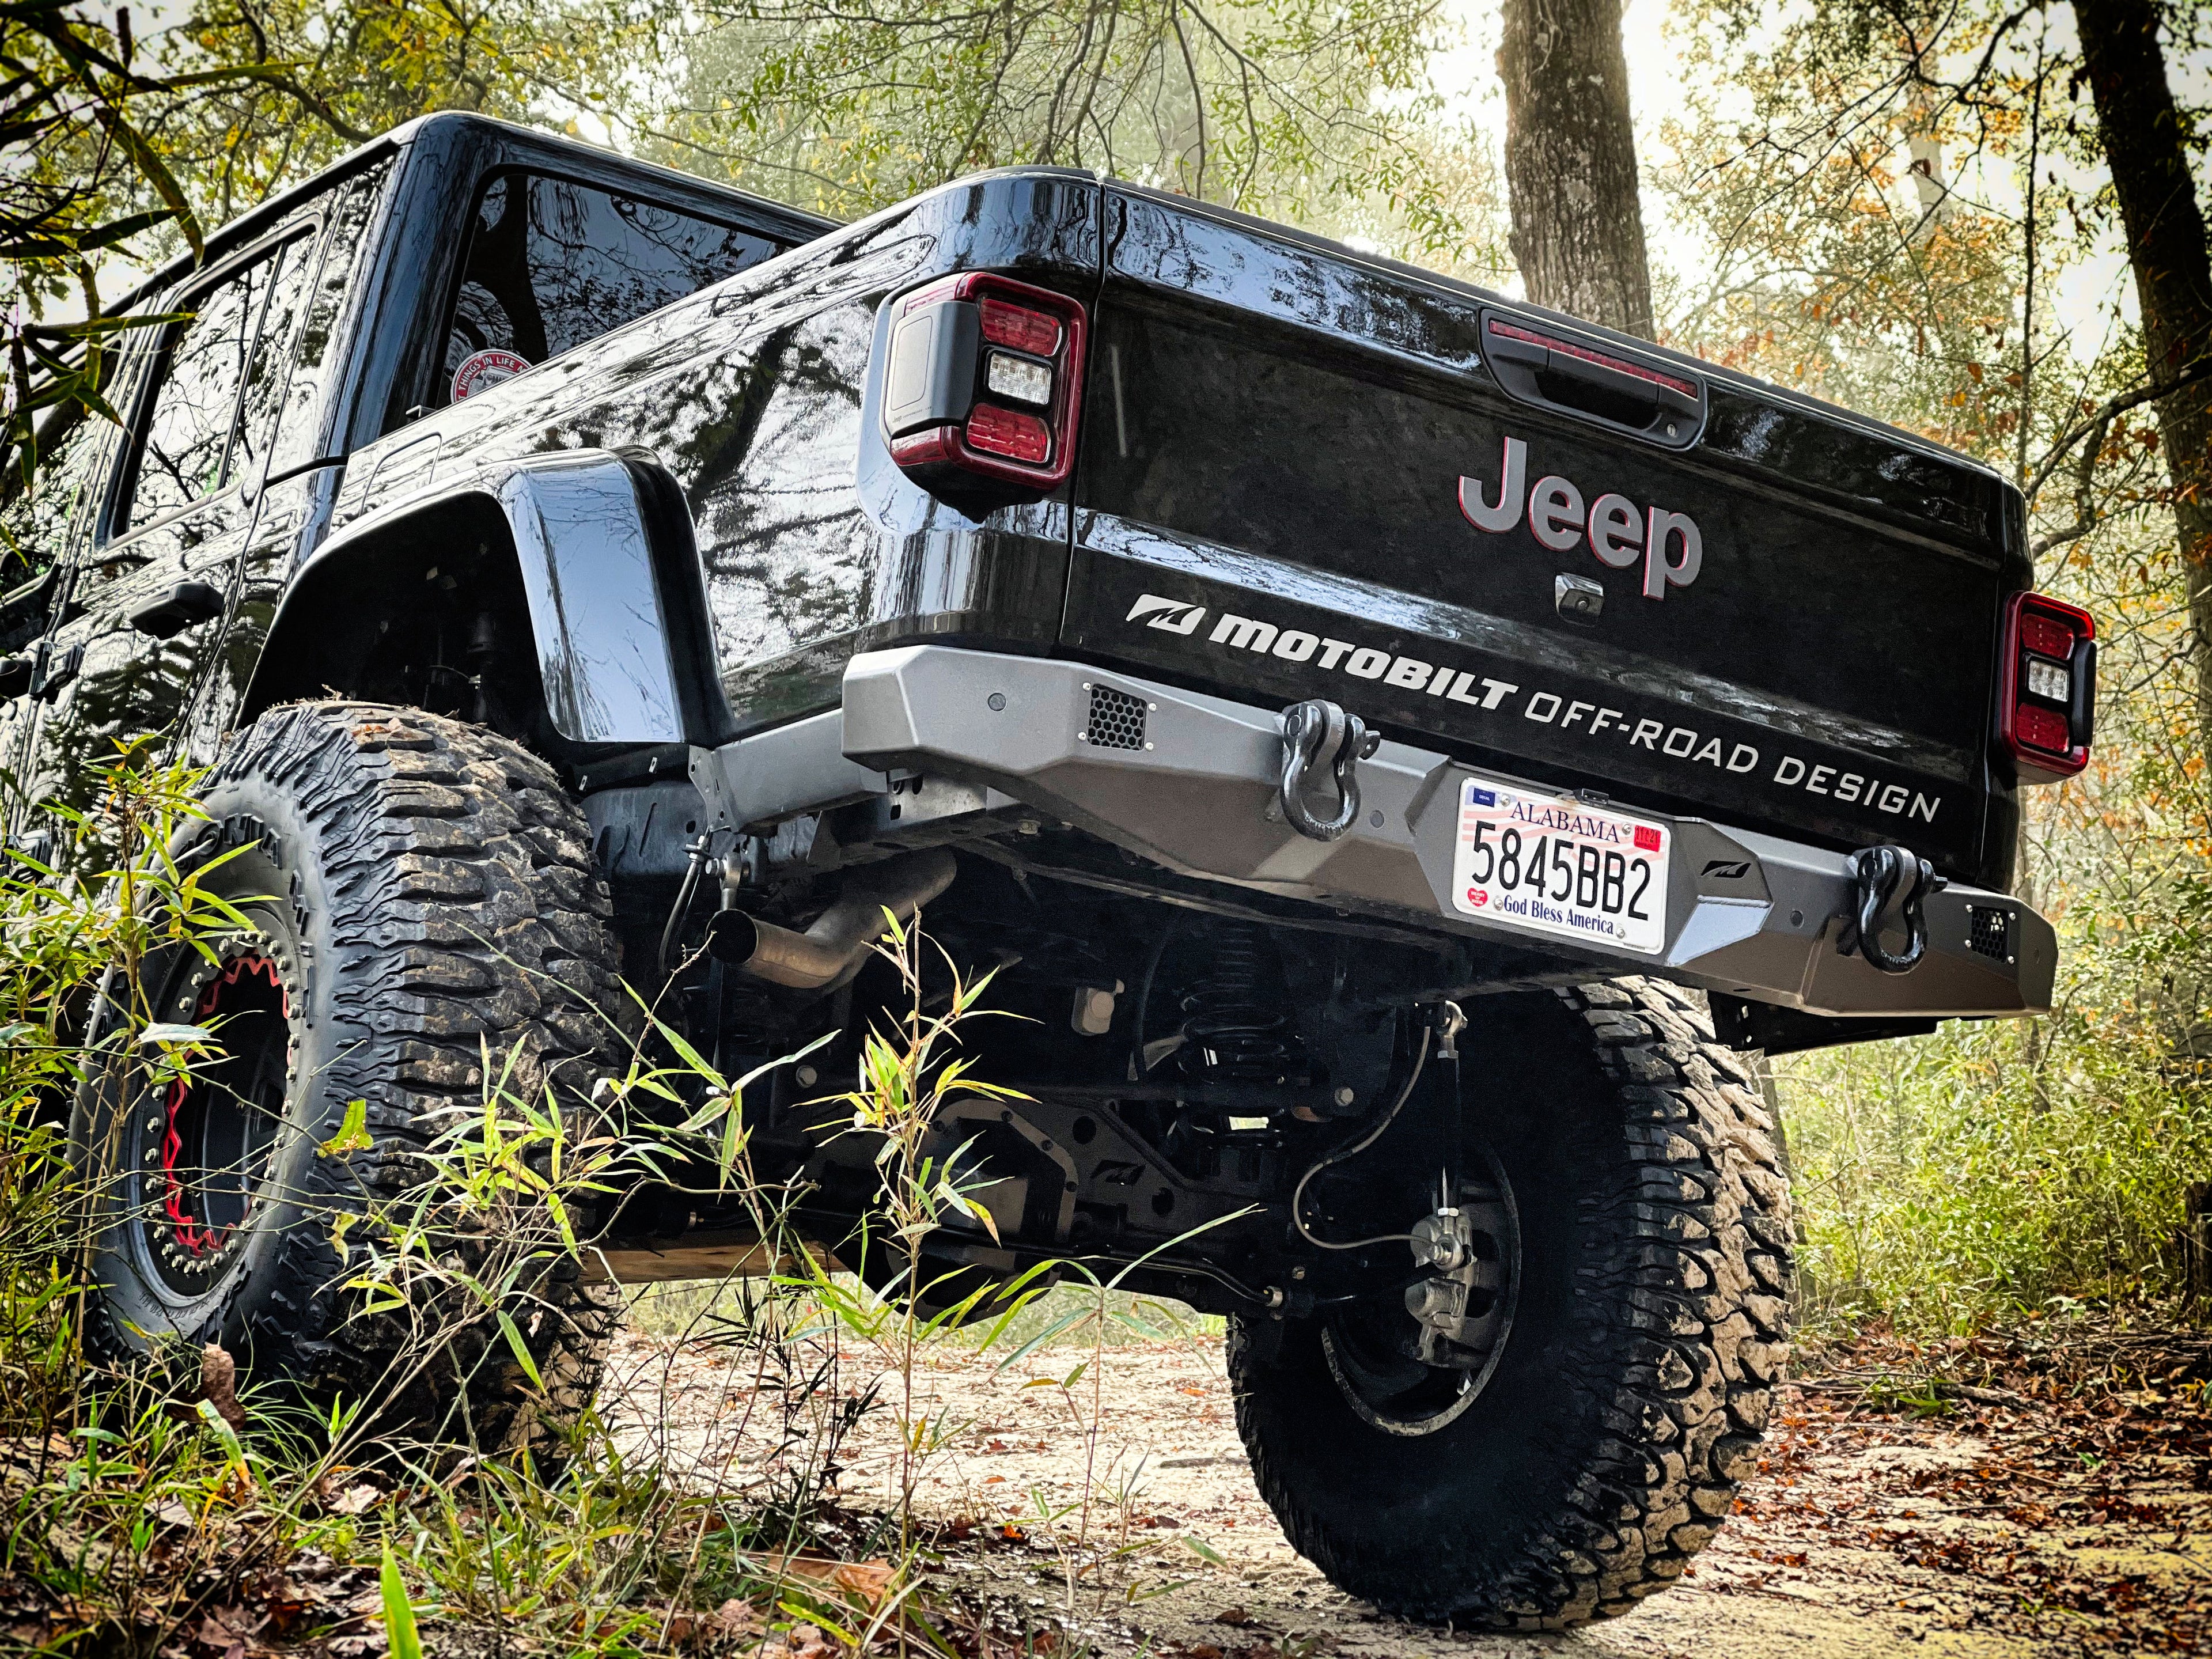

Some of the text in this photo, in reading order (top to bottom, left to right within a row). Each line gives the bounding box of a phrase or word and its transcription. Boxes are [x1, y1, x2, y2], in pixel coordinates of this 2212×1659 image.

[459, 355, 515, 391] THINGS IN LIFE
[1458, 435, 1703, 601] Jeep
[1209, 613, 1941, 823] MOTOBILT OFF-ROAD DESIGN
[1509, 801, 1620, 843] ALABAMA
[1472, 820, 1651, 921] 5845BB2
[1503, 895, 1614, 935] God Bless America
